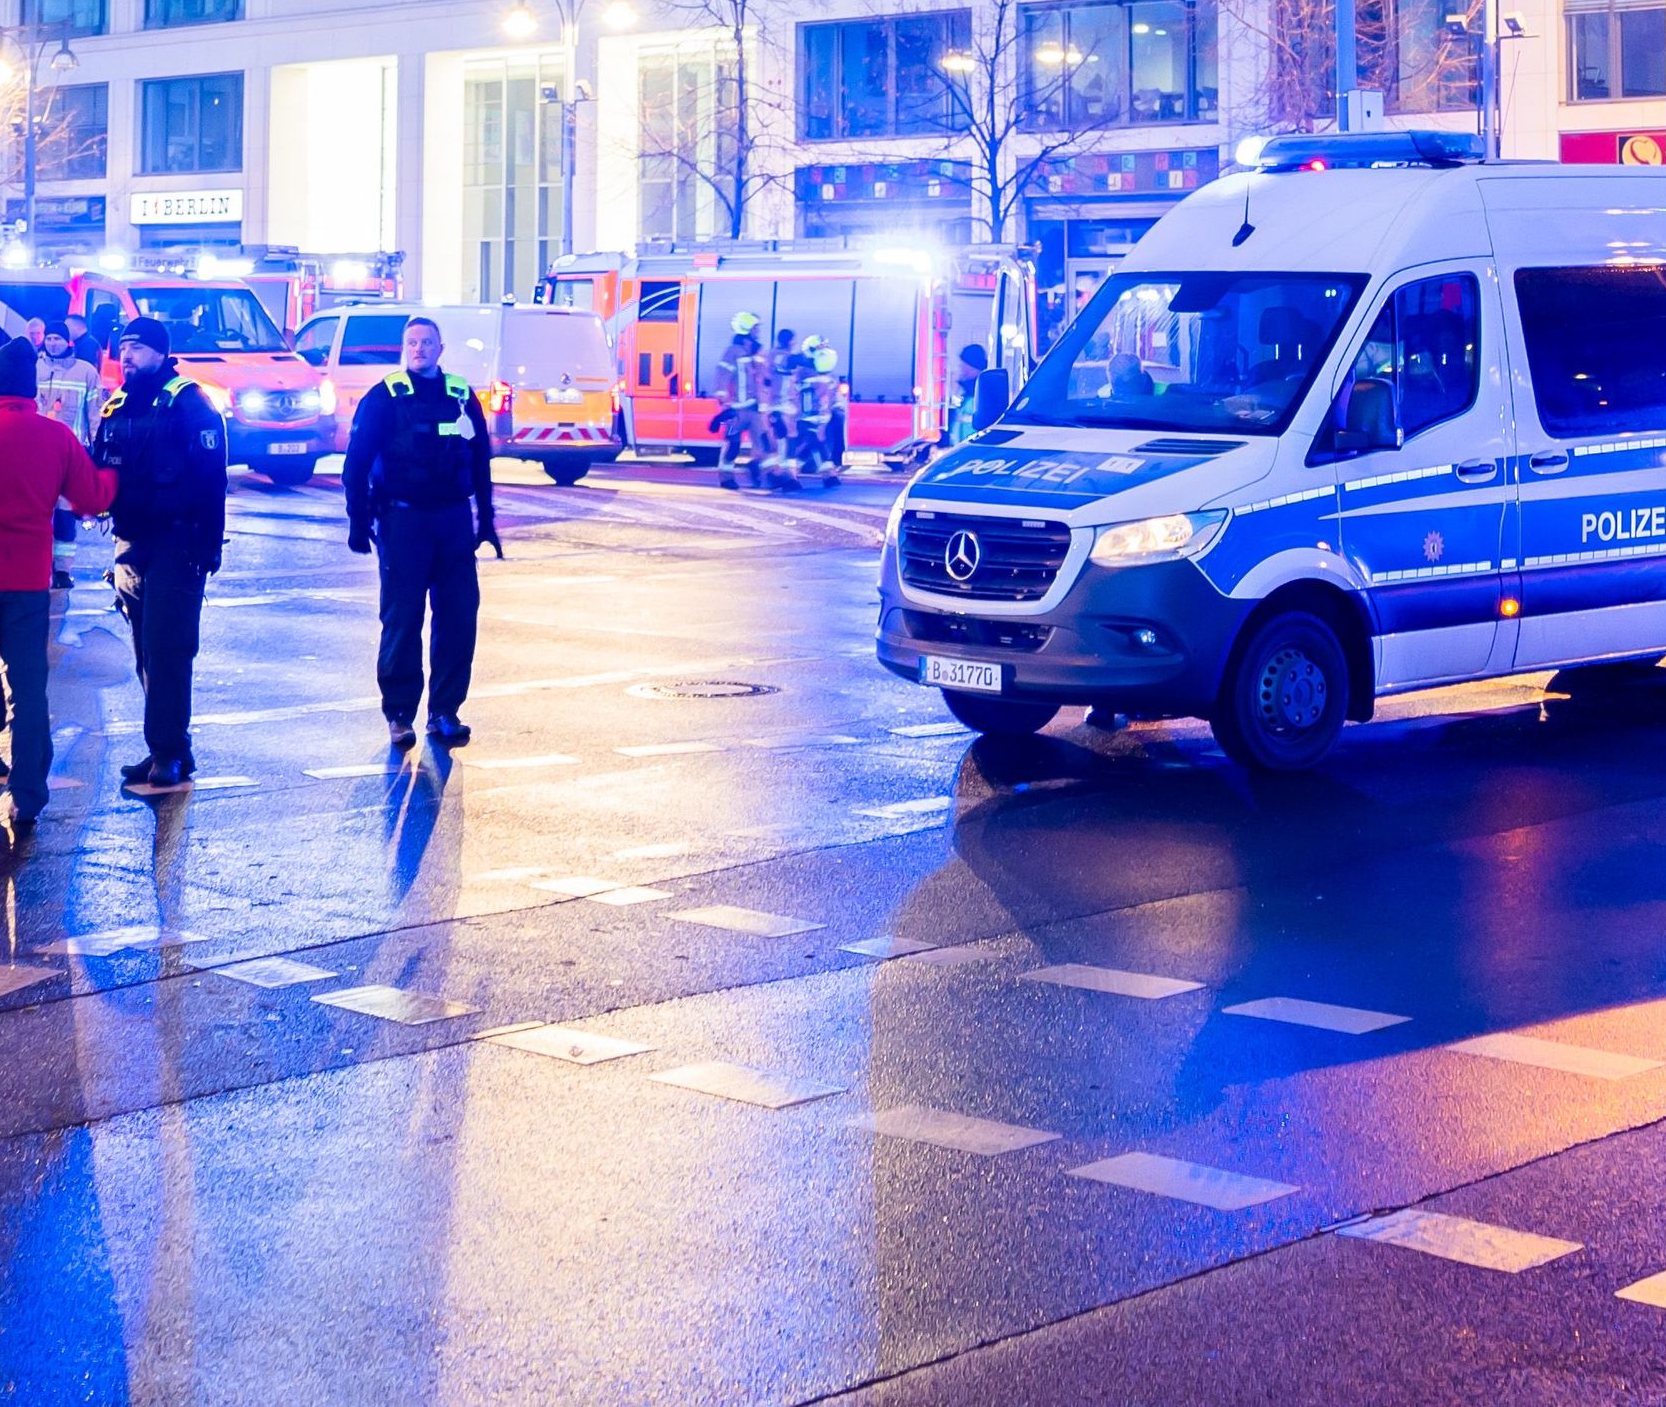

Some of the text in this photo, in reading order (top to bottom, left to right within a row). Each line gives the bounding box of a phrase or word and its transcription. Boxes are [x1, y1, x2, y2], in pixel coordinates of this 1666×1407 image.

[163, 197, 230, 216] BERLIN
[951, 459, 1091, 484] POLIZEI
[933, 661, 993, 686] B 31770
